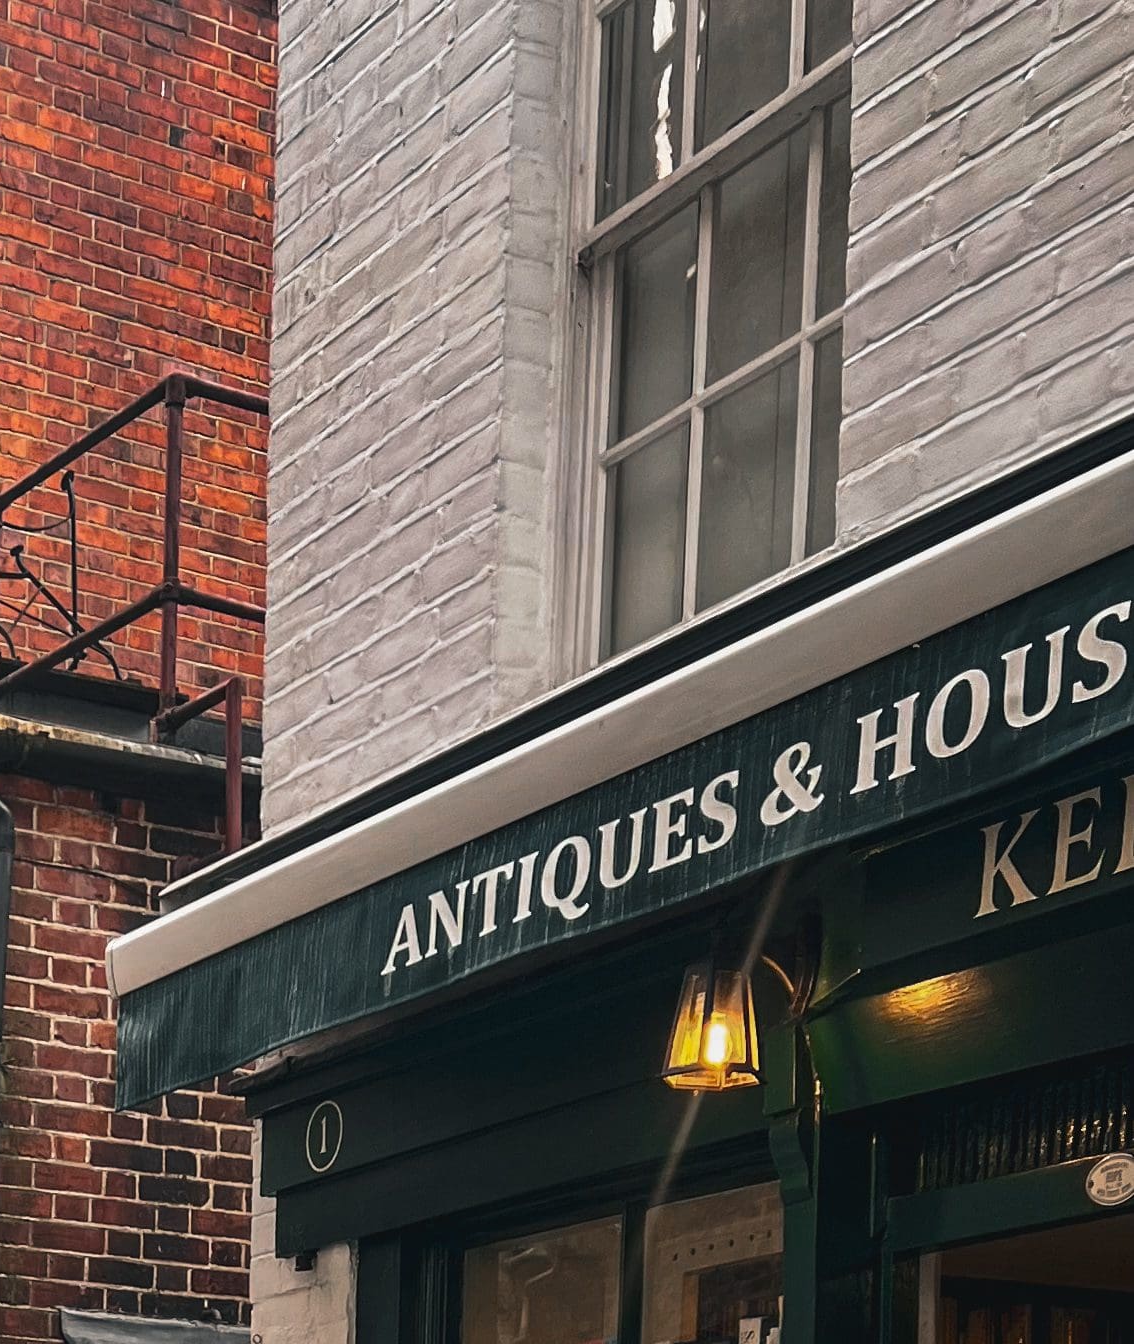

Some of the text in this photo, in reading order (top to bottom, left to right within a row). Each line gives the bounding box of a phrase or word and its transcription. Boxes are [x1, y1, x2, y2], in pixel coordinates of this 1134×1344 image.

[380, 599, 1133, 977] ANTIQUES & HOUS
